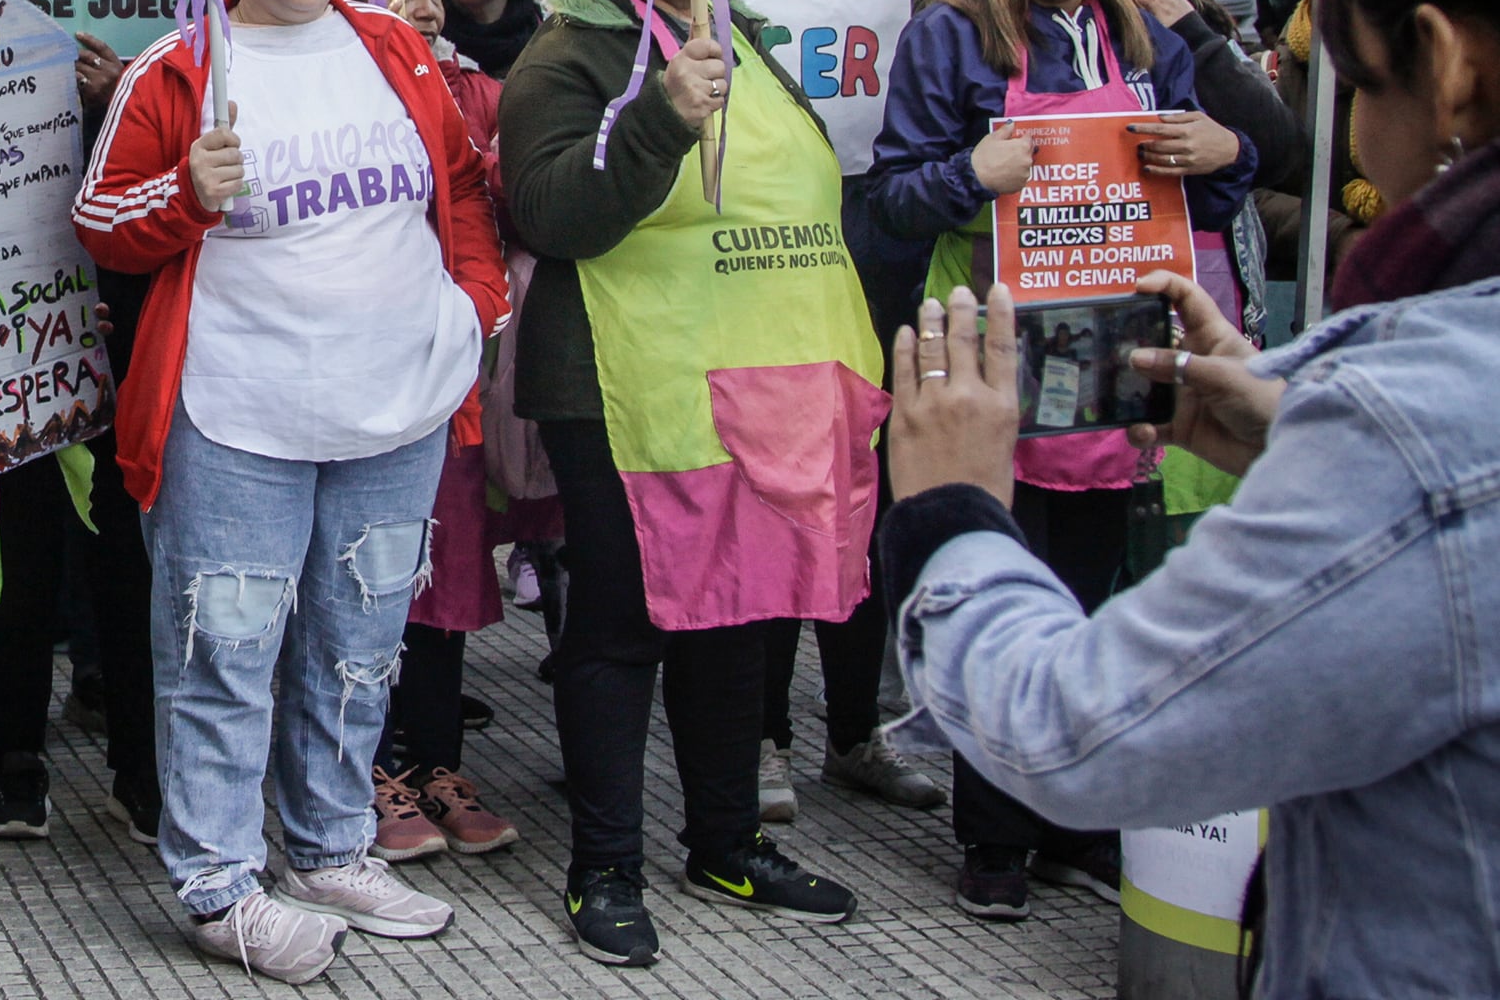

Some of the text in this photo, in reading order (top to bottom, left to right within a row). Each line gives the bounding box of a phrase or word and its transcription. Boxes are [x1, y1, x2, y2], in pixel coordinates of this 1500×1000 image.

[1032, 137, 1070, 146] ENTINA
[1058, 126, 1072, 136] EN
[1019, 180, 1143, 205] ALERTÓ QUE
[1020, 202, 1150, 226] 1 MILLÓN DE
[712, 222, 834, 254] CUIDEMOS
[1019, 225, 1134, 248] CHICXS SE
[789, 252, 819, 270] NOS
[1019, 244, 1175, 268] VAN A DORMIR
[1019, 270, 1061, 290] SIN
[1199, 822, 1228, 843] YA!
